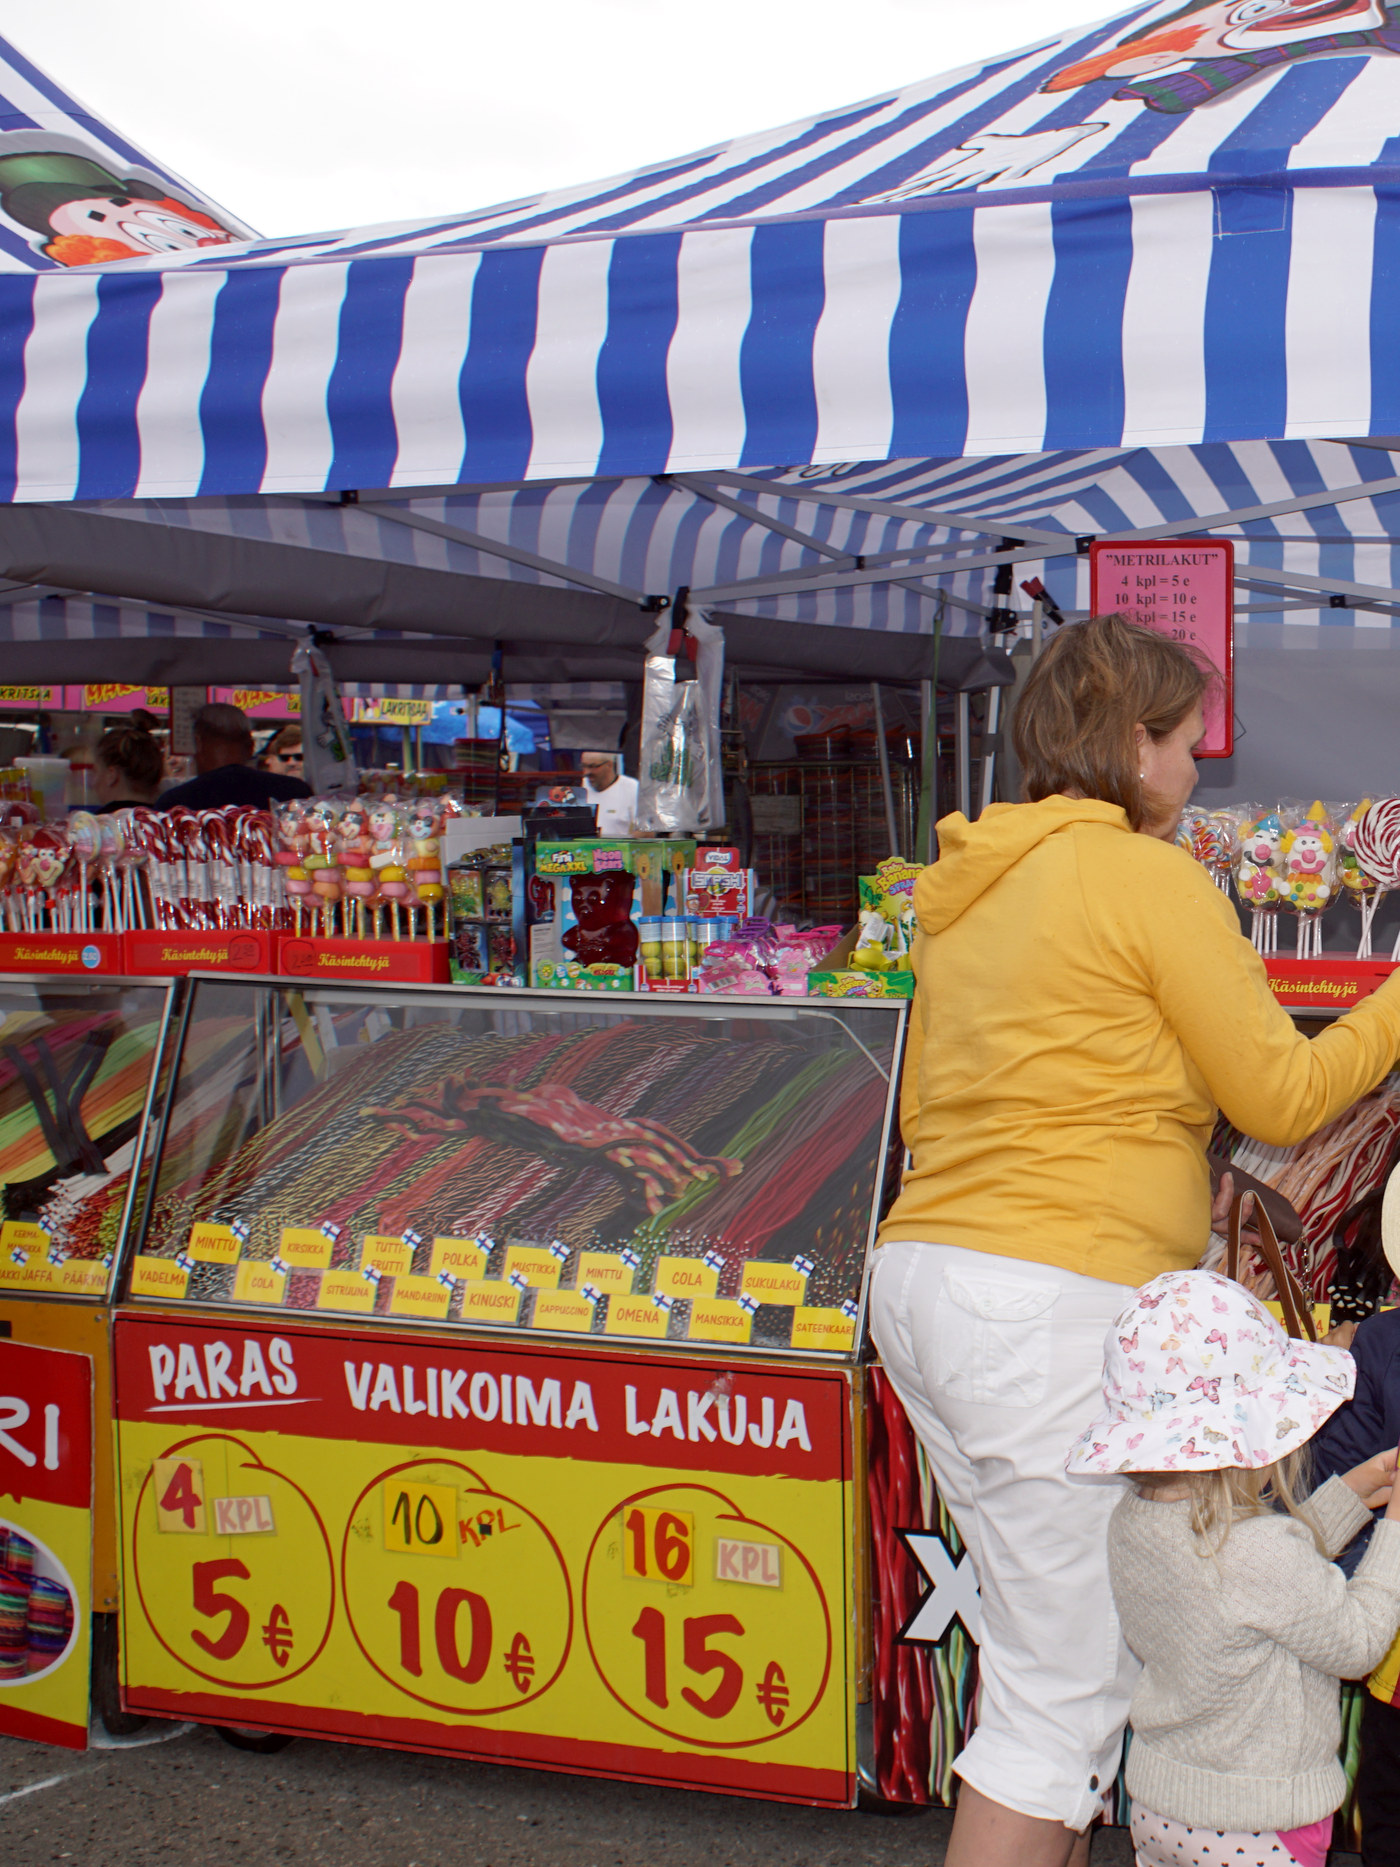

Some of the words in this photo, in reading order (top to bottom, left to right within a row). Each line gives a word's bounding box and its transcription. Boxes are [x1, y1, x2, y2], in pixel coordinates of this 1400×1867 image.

[1121, 576, 1128, 586] 4
[1136, 575, 1157, 589] kpl
[1171, 575, 1179, 587] 5
[1183, 578, 1190, 587] e
[1115, 593, 1129, 605] 10
[1136, 593, 1157, 607] kpl
[1172, 593, 1187, 605] 10
[1190, 597, 1197, 605] e
[1136, 611, 1157, 625] kpl
[1172, 611, 1187, 623] 15
[1190, 614, 1197, 623] e
[1172, 629, 1186, 641] 20
[1190, 632, 1197, 641] e
[161, 948, 229, 966] Käsintehtyjä
[318, 953, 390, 971] Käsintehtyjä
[1268, 978, 1358, 998] Käsintehtyjä
[195, 1237, 237, 1252] MINTTU
[287, 1243, 324, 1255] KIRSIKKA
[375, 1241, 406, 1254] TUTTI-
[443, 1253, 478, 1267] POLKA
[23, 1269, 53, 1282] JAFFA
[511, 1261, 556, 1275] MUSTIKKA
[586, 1268, 622, 1280] MINTTU
[139, 1271, 186, 1286] VADELMA
[251, 1277, 275, 1289] COLA
[672, 1271, 703, 1287] COLA
[745, 1276, 801, 1291] SUKULAKU
[326, 1285, 369, 1298] SITRUUNA
[396, 1288, 448, 1304] MANDARIINI
[468, 1294, 516, 1309] KINUSKI
[616, 1309, 660, 1324] OMENA
[695, 1313, 744, 1328] MANSIKKA
[149, 1337, 298, 1401] PARAS
[344, 1360, 599, 1432] VALIKOIMA
[625, 1384, 812, 1452] LAKUJA
[160, 1463, 202, 1529] 4
[217, 1497, 271, 1533] KPL
[391, 1491, 444, 1545] 10
[625, 1508, 691, 1581] 16
[718, 1542, 779, 1582] KPL
